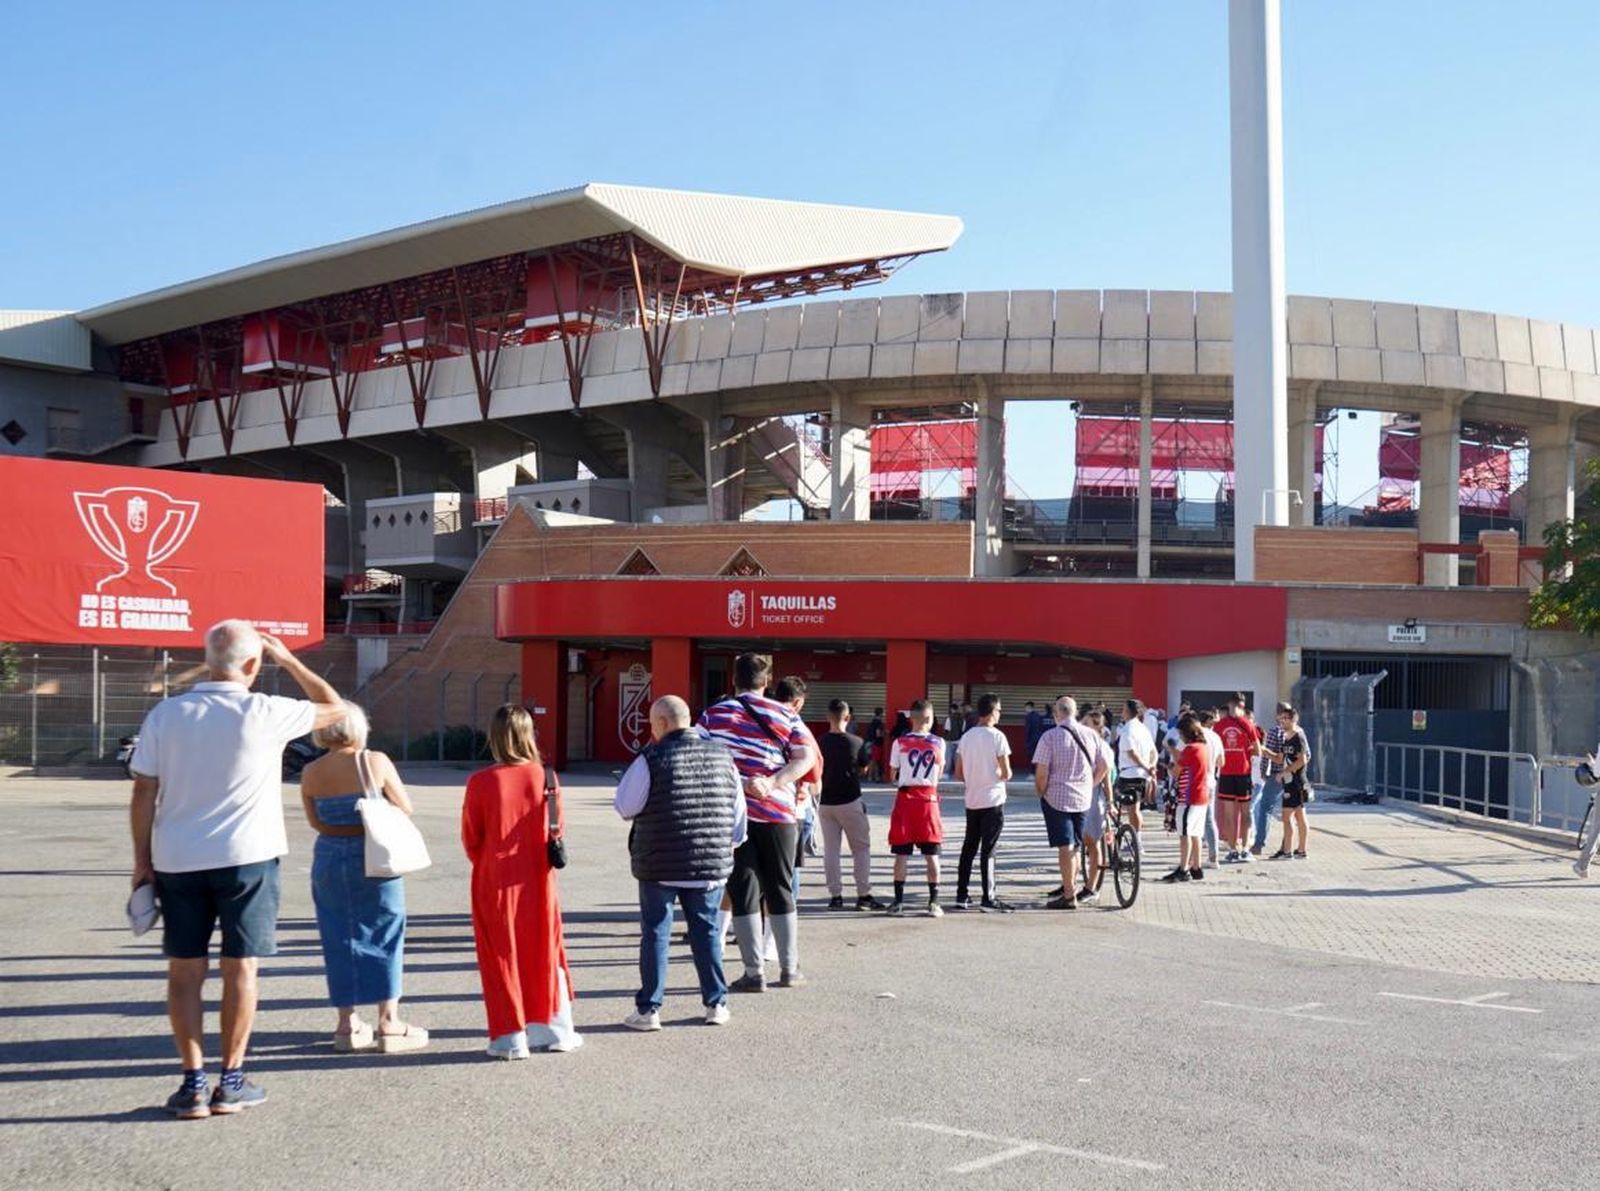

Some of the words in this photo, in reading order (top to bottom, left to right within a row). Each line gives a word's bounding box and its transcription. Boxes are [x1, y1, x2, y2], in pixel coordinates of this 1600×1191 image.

[101, 595, 117, 610] ES
[760, 596, 836, 611] TAQUILLAS
[79, 609, 98, 627] ES
[101, 610, 118, 628] EL
[761, 615, 790, 623] TICKET
[793, 615, 824, 623] OFFICE
[908, 749, 936, 779] 99
